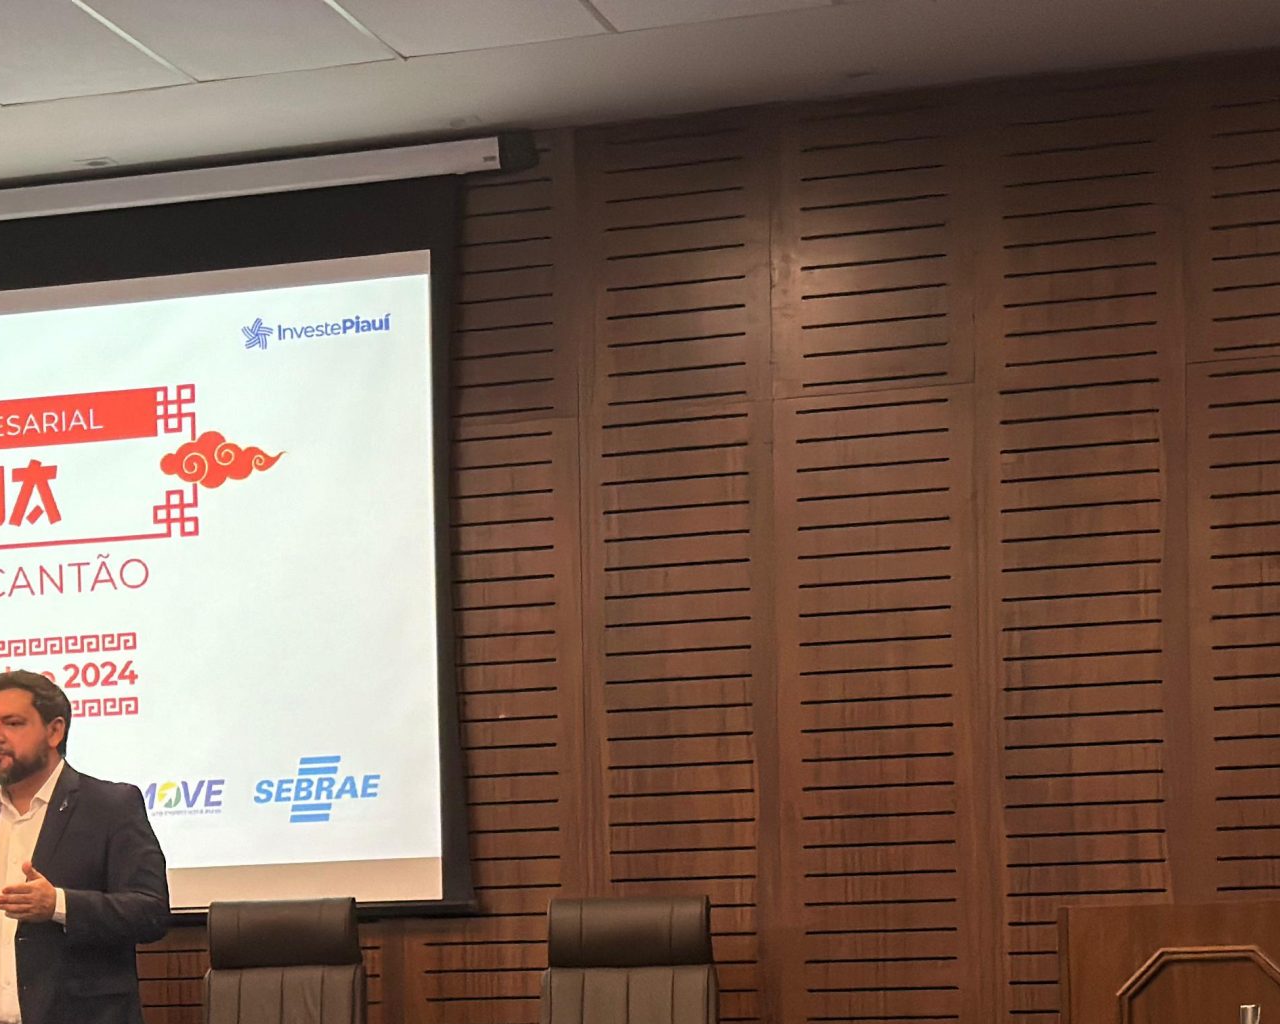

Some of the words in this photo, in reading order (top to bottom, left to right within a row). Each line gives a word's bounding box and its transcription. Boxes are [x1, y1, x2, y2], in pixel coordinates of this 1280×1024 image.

[278, 313, 391, 341] InvestePiauí
[63, 659, 140, 689] 2024
[253, 774, 382, 805] SEBRAE
